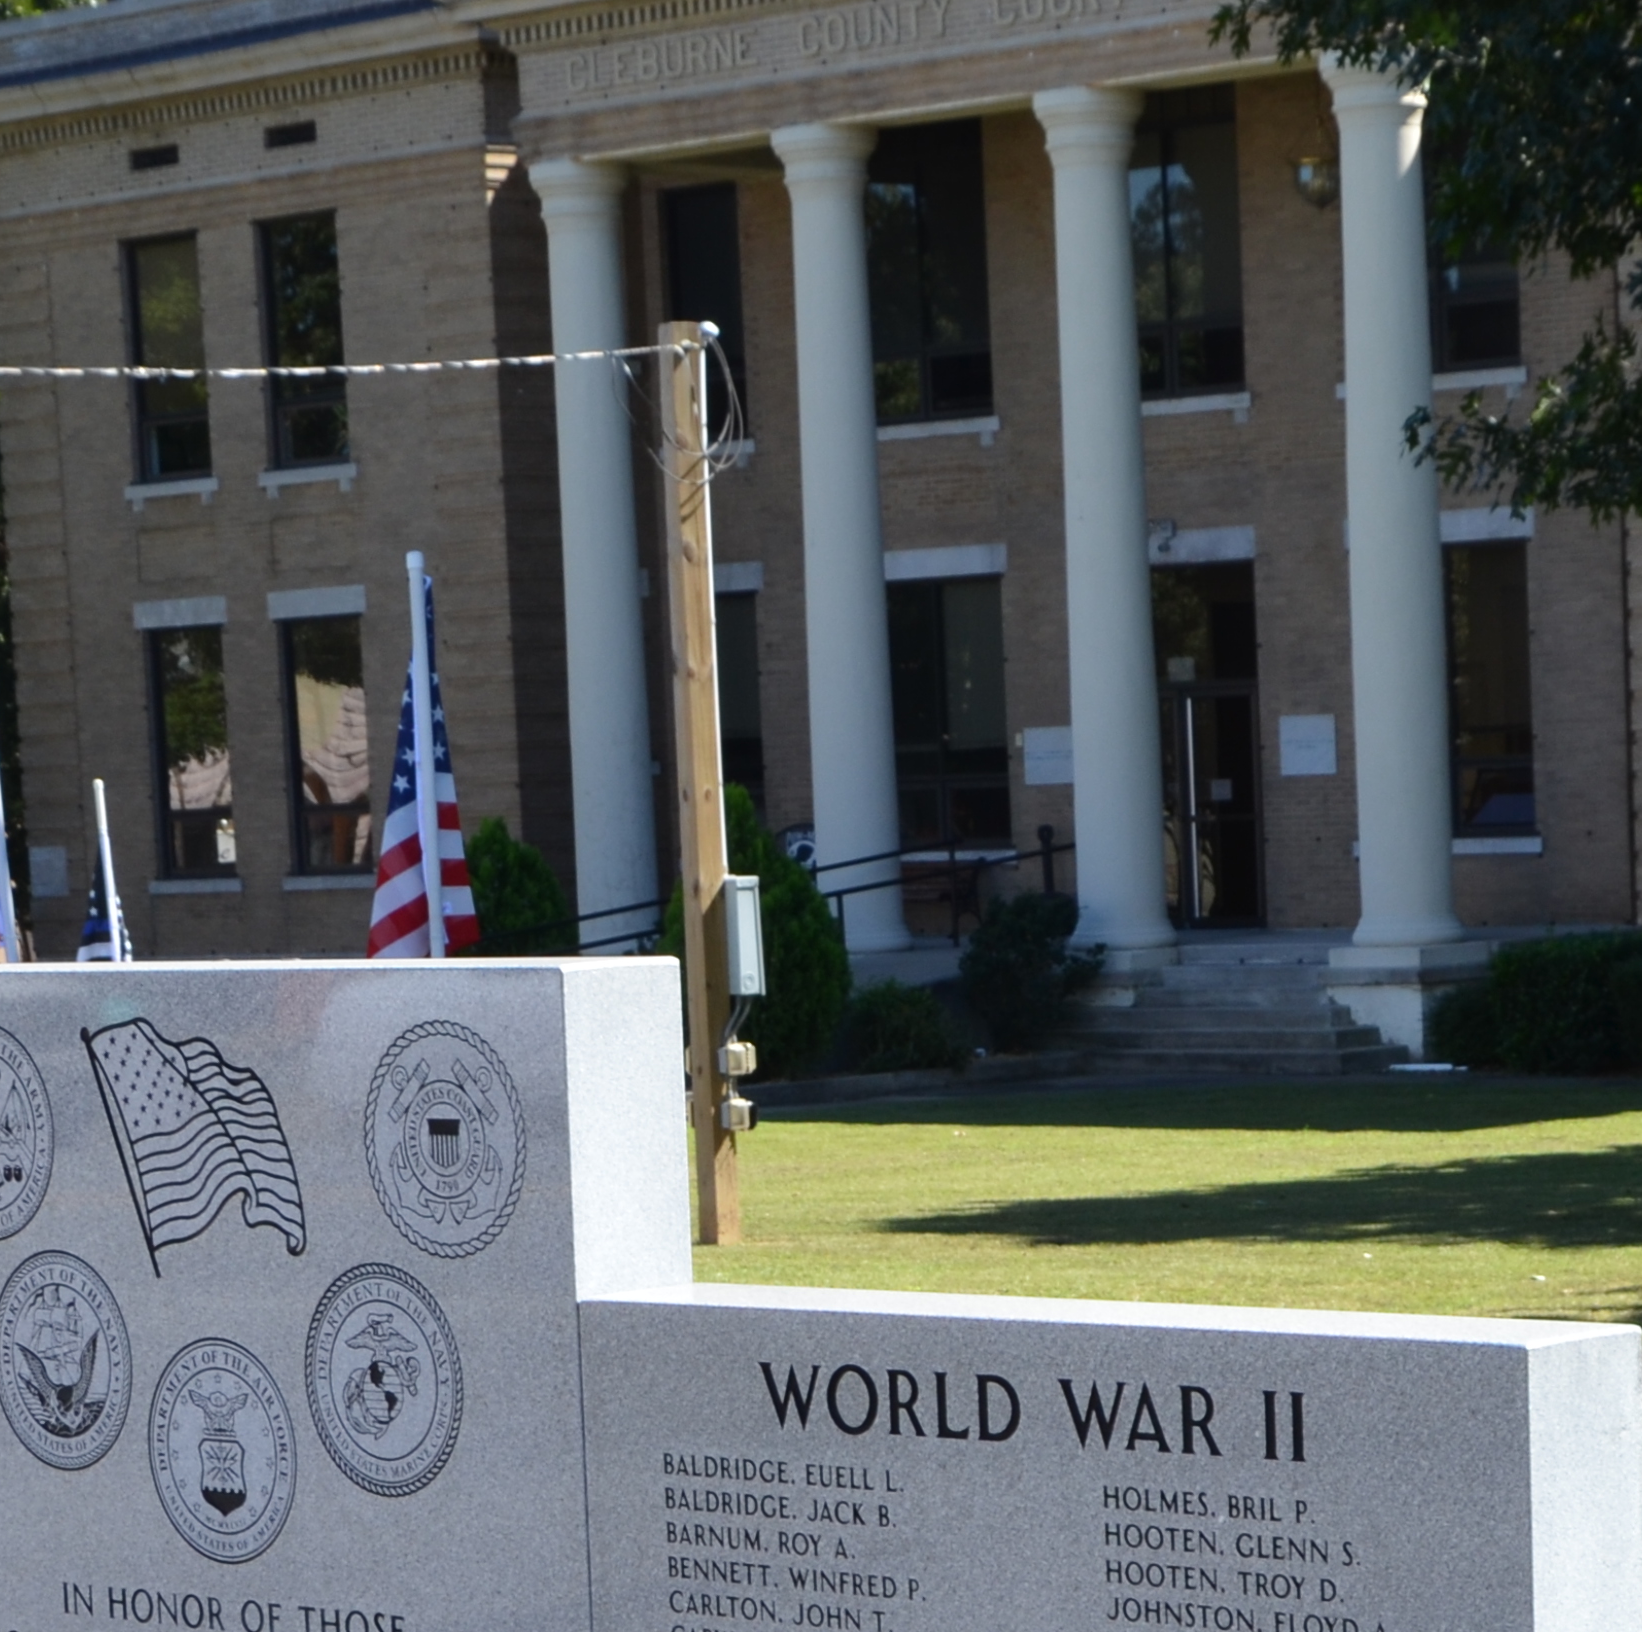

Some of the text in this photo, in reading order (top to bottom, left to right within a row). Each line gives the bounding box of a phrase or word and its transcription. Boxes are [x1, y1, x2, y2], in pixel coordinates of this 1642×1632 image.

[564, 28, 758, 92] CLEBURNE
[798, 0, 952, 58] COUNTY
[757, 1361, 1306, 1462] WORLD WAR II
[805, 1463, 873, 1490] EUELL
[1227, 1495, 1281, 1521] BRIL
[778, 1530, 820, 1556] ROY
[62, 1581, 94, 1614] IN
[107, 1586, 225, 1630] HONOR
[793, 1603, 860, 1629] JOHN
